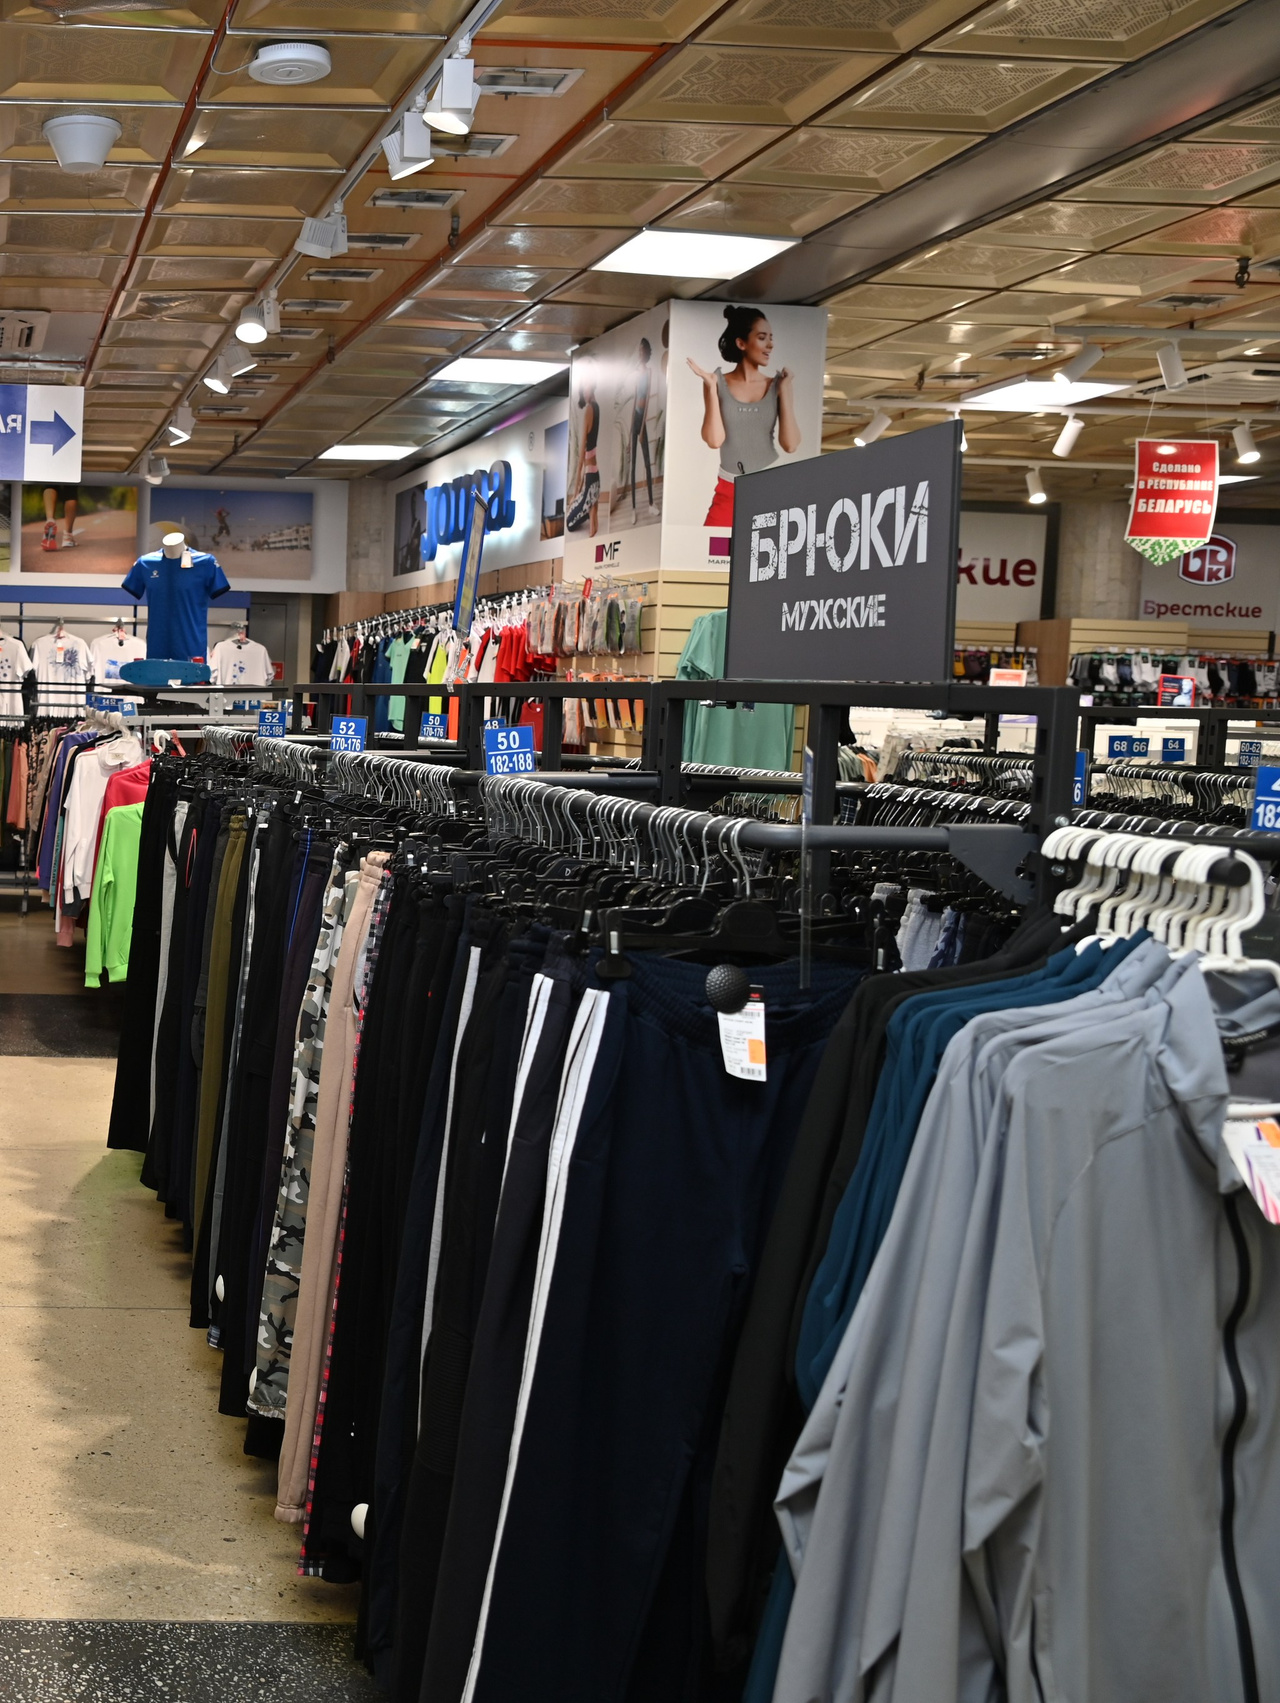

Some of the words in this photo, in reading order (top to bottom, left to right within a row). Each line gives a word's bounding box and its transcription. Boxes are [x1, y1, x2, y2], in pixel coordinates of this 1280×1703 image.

[1152, 462, 1201, 473] Сделано
[1138, 480, 1145, 489] в
[1147, 479, 1213, 491] РЕСПУБЛИКЕ
[1137, 499, 1212, 514] БЕЛАРУСЬ
[749, 480, 929, 582] БРЮКИ
[781, 594, 886, 631] МУЖСКИЕ
[1143, 600, 1262, 619] Брестские
[264, 712, 279, 723] 52
[428, 715, 440, 725] 50
[259, 725, 283, 736] 182-188
[339, 721, 355, 735] 52
[423, 727, 444, 737] 170-176
[332, 737, 361, 751] 170-176
[497, 731, 520, 750] 50
[1113, 740, 1127, 751] 68
[1167, 740, 1180, 750] 64
[1132, 741, 1147, 753] 66
[1240, 742, 1261, 753] 60-62
[490, 753, 533, 773] 182-188
